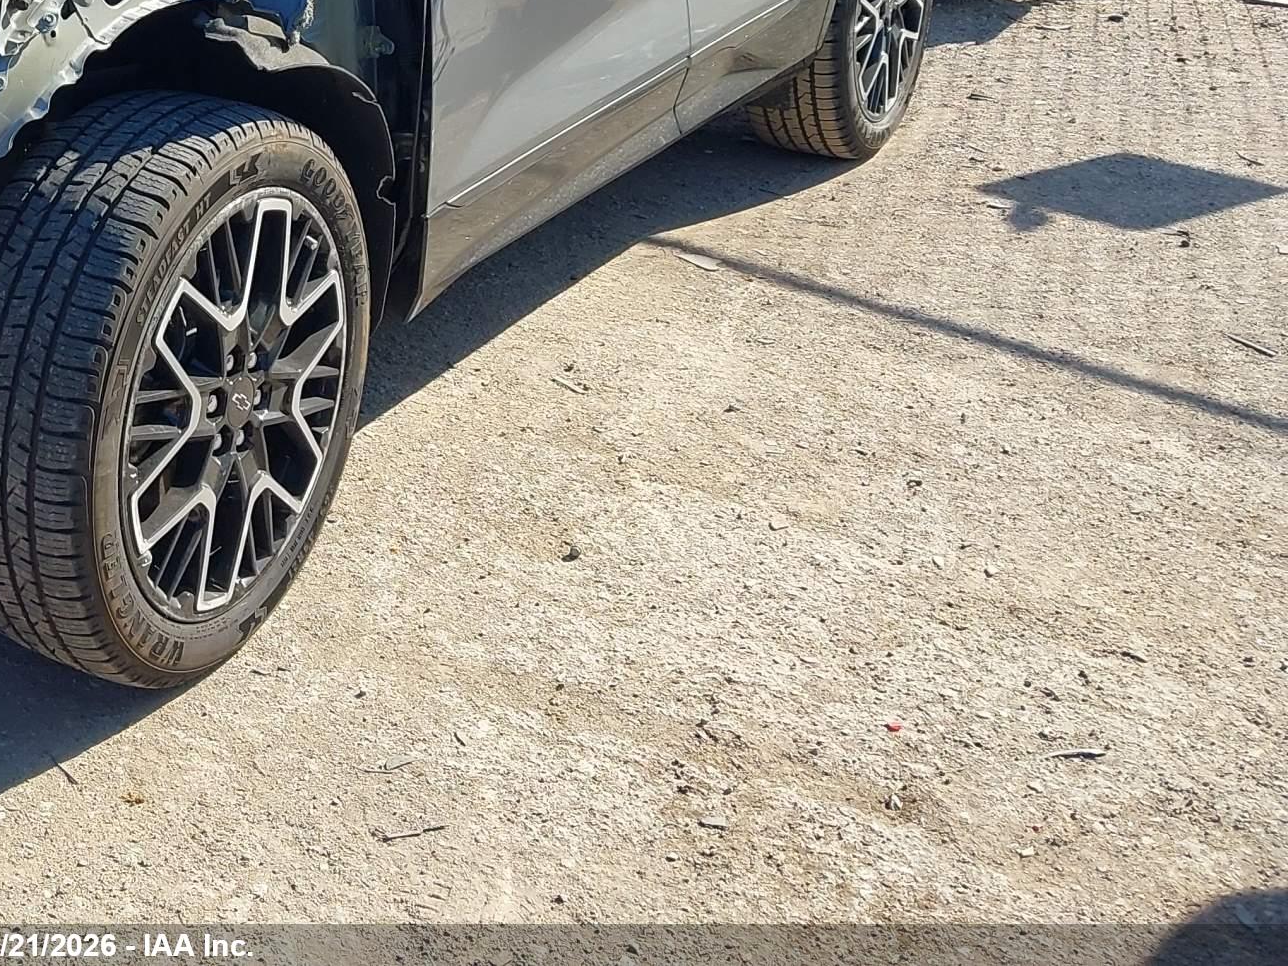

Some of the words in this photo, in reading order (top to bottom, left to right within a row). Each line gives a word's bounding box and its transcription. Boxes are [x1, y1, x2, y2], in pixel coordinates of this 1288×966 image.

[136, 219, 193, 326] STEADFAST
[194, 192, 212, 220] HT
[100, 533, 185, 666] WRANGLER
